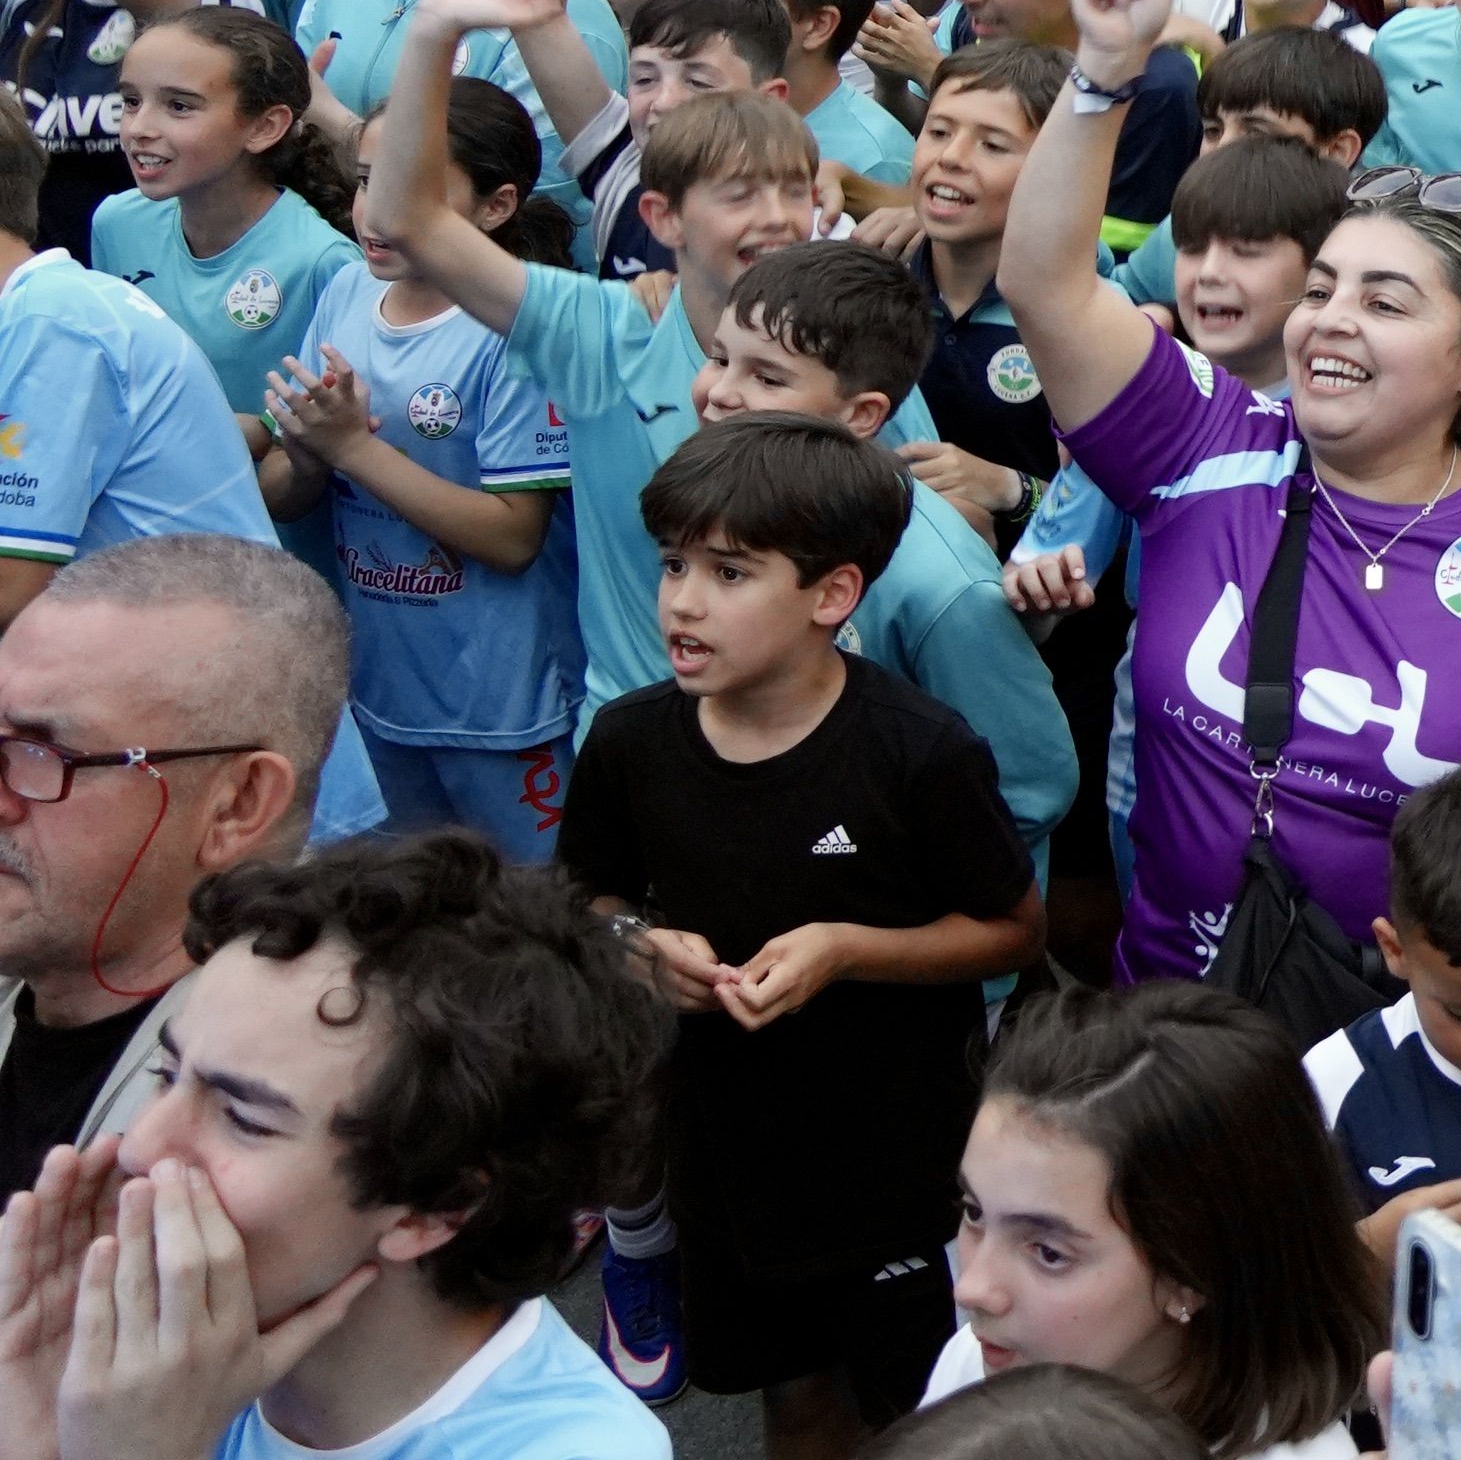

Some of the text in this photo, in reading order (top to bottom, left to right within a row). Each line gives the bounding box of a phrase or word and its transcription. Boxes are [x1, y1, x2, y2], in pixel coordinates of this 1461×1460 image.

[536, 444, 551, 455] de
[1162, 698, 1187, 719] LA
[811, 843, 858, 854] adidas
